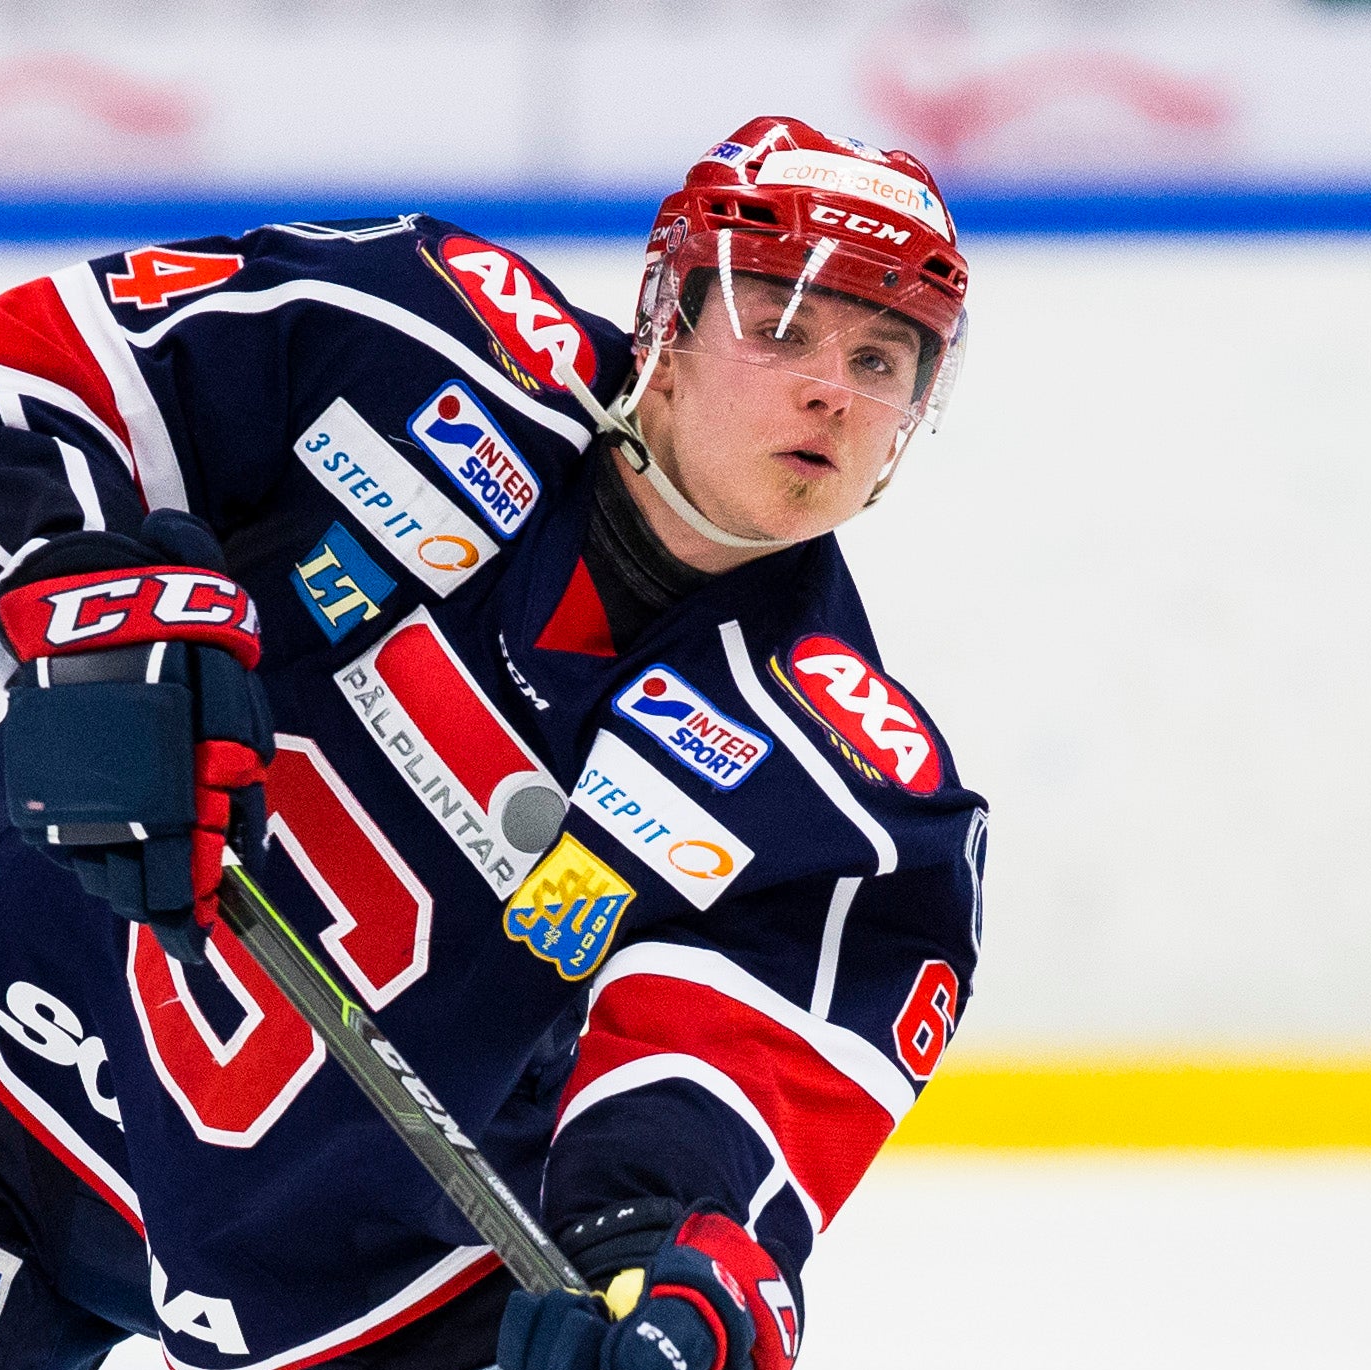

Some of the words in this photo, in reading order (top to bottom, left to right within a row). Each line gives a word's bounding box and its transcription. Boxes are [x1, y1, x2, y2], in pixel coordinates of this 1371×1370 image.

[809, 203, 912, 246] CCM
[448, 250, 581, 385] AXA
[305, 432, 331, 454] 3
[322, 451, 393, 509] STEP
[383, 511, 423, 539] IT
[458, 456, 522, 526] SPORT
[474, 436, 535, 511] INTER
[295, 543, 381, 628] LT
[668, 727, 748, 780] SPORT
[685, 712, 759, 764] INTER
[793, 653, 930, 786] AXA
[341, 665, 516, 887] PÅLPLINTAR
[633, 810, 672, 846] IT
[892, 958, 960, 1081] 6
[370, 1037, 478, 1151] CCM
